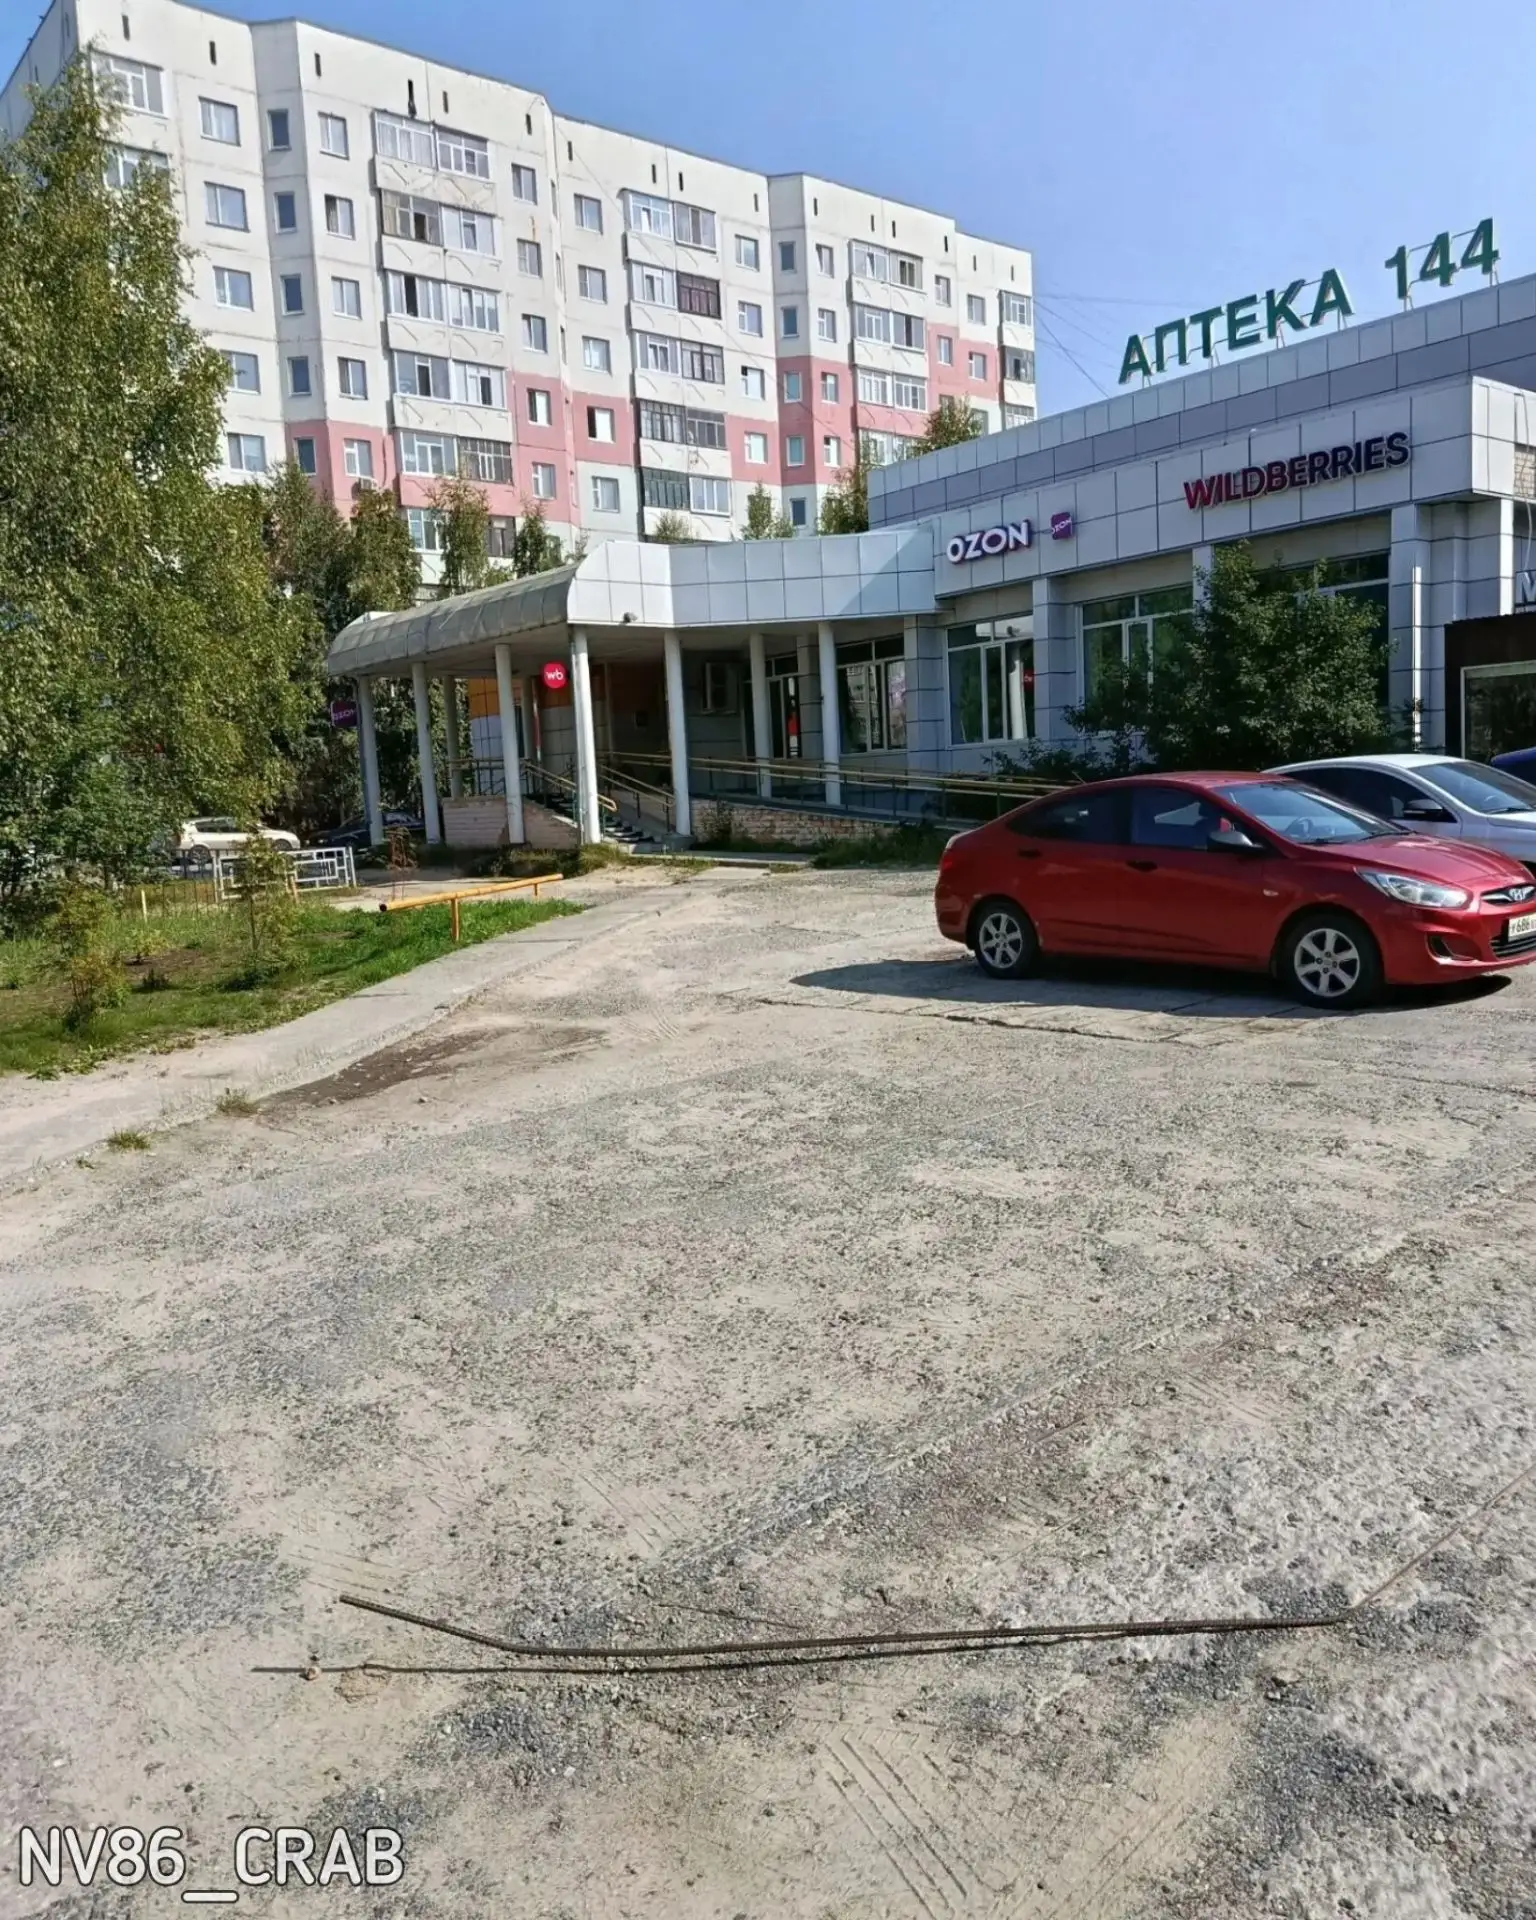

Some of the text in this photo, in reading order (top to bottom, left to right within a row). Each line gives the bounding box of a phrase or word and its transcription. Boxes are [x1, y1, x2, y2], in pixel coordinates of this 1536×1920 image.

[1118, 217, 1500, 384] АПТЕКА 144
[1184, 431, 1411, 510] WILDBERRIES
[946, 520, 1031, 564] OZON
[545, 668, 564, 680] wb
